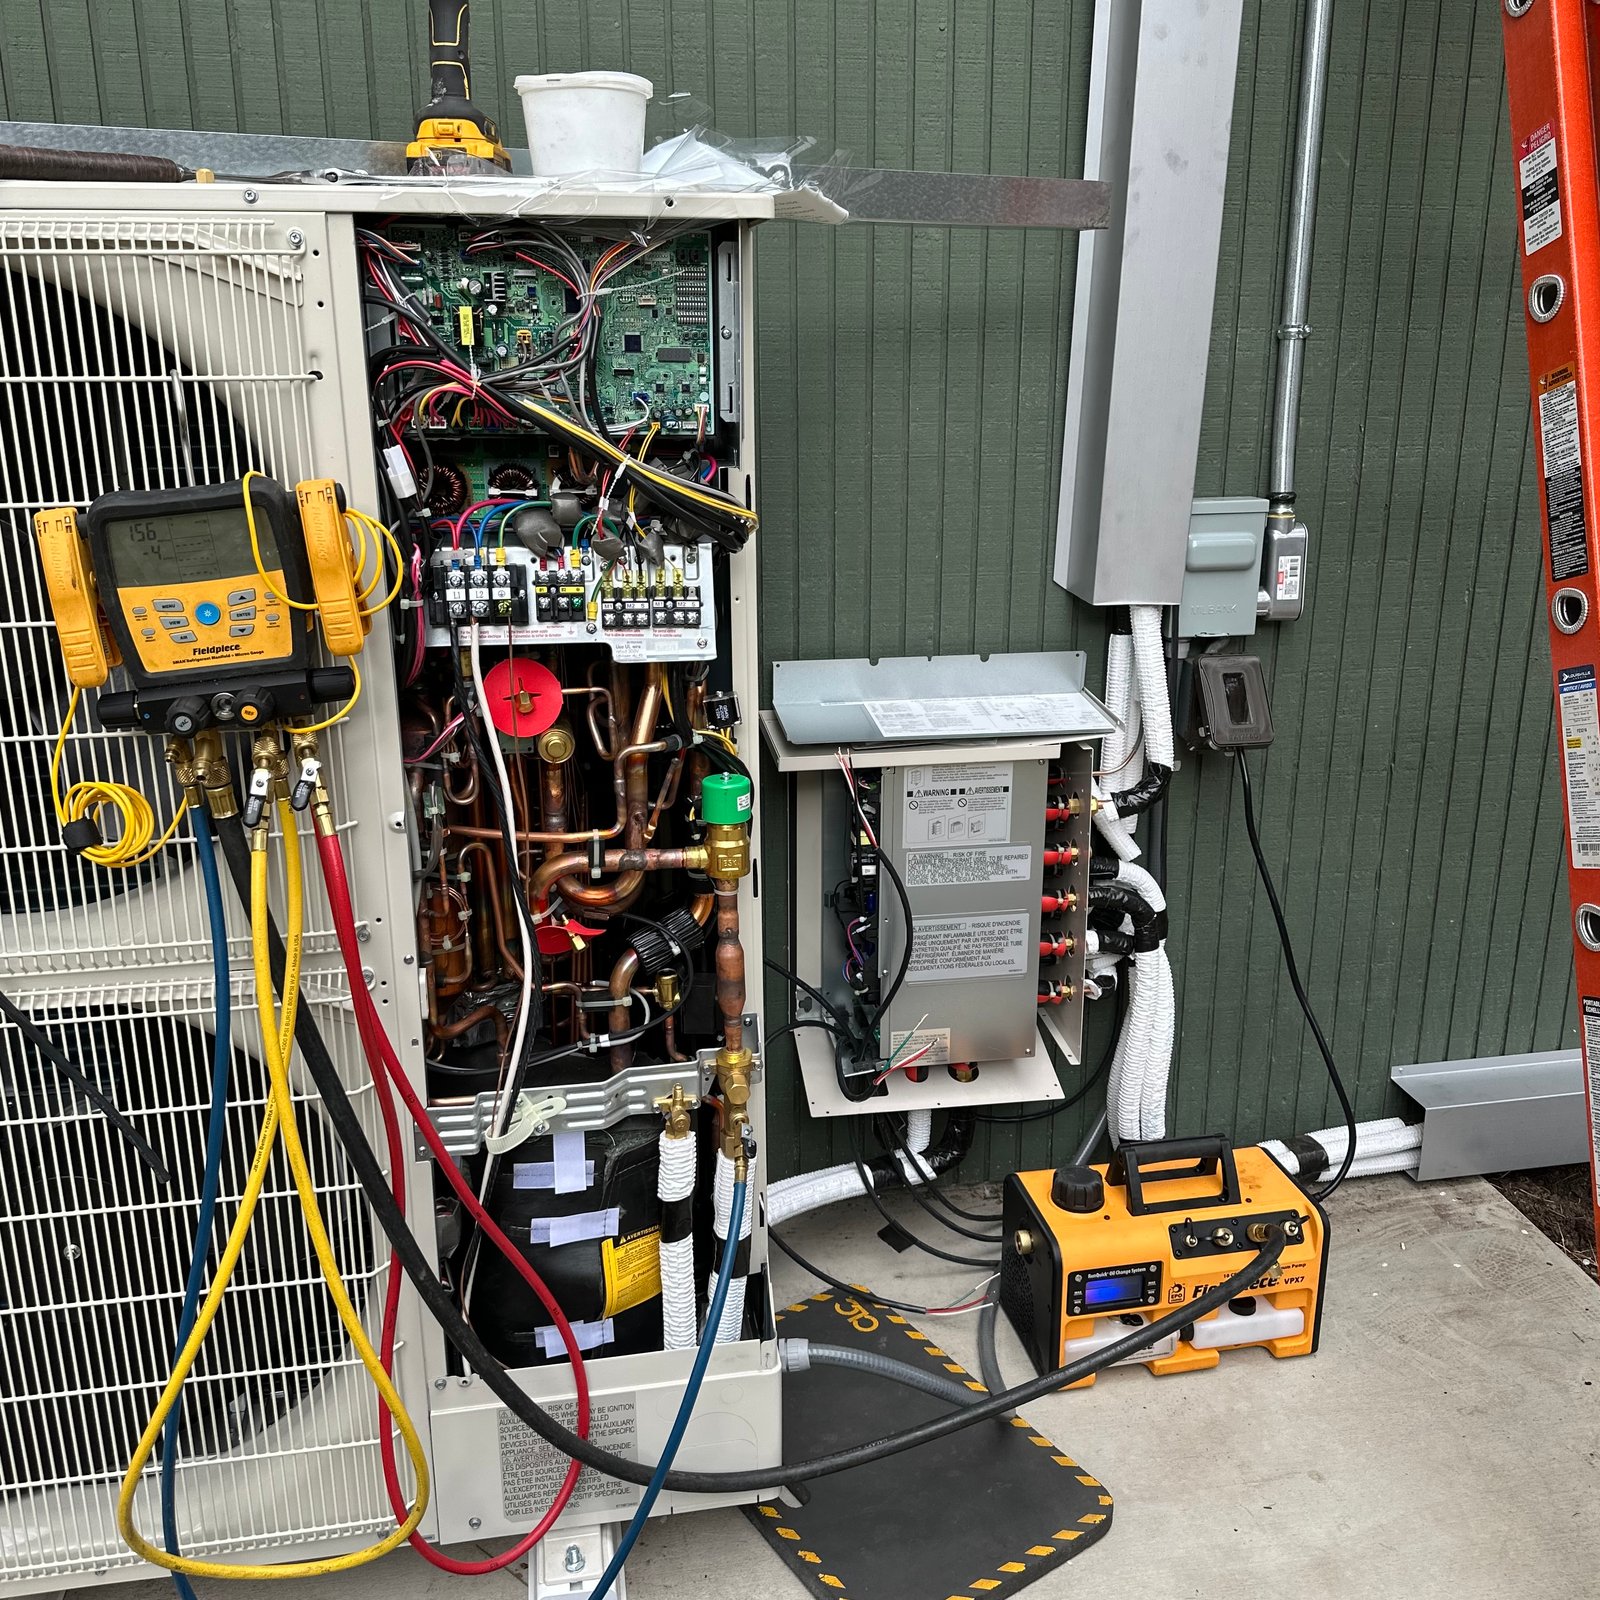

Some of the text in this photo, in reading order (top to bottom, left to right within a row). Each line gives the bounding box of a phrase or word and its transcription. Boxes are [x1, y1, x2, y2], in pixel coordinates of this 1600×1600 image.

[1530, 122, 1551, 142] DANGER
[1530, 131, 1552, 151] PELIGRO
[129, 523, 157, 542] 156
[453, 591, 461, 599] L1
[475, 590, 484, 598] L2
[192, 644, 241, 656] Fieldpiece
[923, 788, 950, 797] WARNING
[974, 785, 1003, 794] AVERTISSEMENT
[1003, 853, 1029, 861] REPAIRED
[918, 924, 961, 932] AVERTISSEMENT
[992, 919, 1021, 928] D'INCENDIE
[914, 933, 942, 941] FRIGÉRANT
[943, 930, 976, 939] INFLAMMABLE
[928, 938, 960, 946] UNIQUEMENT
[982, 941, 1003, 949] PERCER
[1010, 939, 1023, 947] TUBE
[951, 949, 975, 957] ÉLIMINER
[982, 947, 1005, 955] MANIÈRE
[909, 958, 938, 966] PPROPRIÉE
[984, 959, 993, 967] OU
[1291, 1262, 1307, 1270] Pump
[1116, 1268, 1131, 1277] Change
[1131, 1267, 1147, 1275] System
[1284, 1276, 1305, 1285] VPX7
[547, 1404, 563, 1412] RISK
[561, 1410, 580, 1418] WHIC
[607, 1403, 635, 1413] IGNITION
[500, 1425, 531, 1434] SOURCES
[508, 1432, 521, 1440] THE
[603, 1418, 635, 1429] AUXILIARY
[501, 1440, 528, 1450] DEVICES
[608, 1426, 635, 1436] SPECIFIC
[538, 1444, 551, 1452] SEE
[503, 1459, 553, 1472] LES DISPOSITIFS
[502, 1465, 565, 1480] ÊTRE DES SOURCES
[503, 1479, 516, 1487] PAS
[517, 1476, 534, 1486] ÊTRE
[587, 1469, 599, 1477] LES
[510, 1483, 549, 1494] L'EXCEPTION
[550, 1480, 562, 1489] DES
[577, 1475, 602, 1485] OSITIFS
[504, 1490, 542, 1501] AUXILIAIRES
[587, 1483, 605, 1492] POUR
[606, 1480, 623, 1490] ÊTRE
[504, 1500, 532, 1510] UTILISÉS
[532, 1497, 550, 1506] AVEC
[571, 1491, 593, 1501] POSITIF
[505, 1506, 534, 1517] VOIR LES
